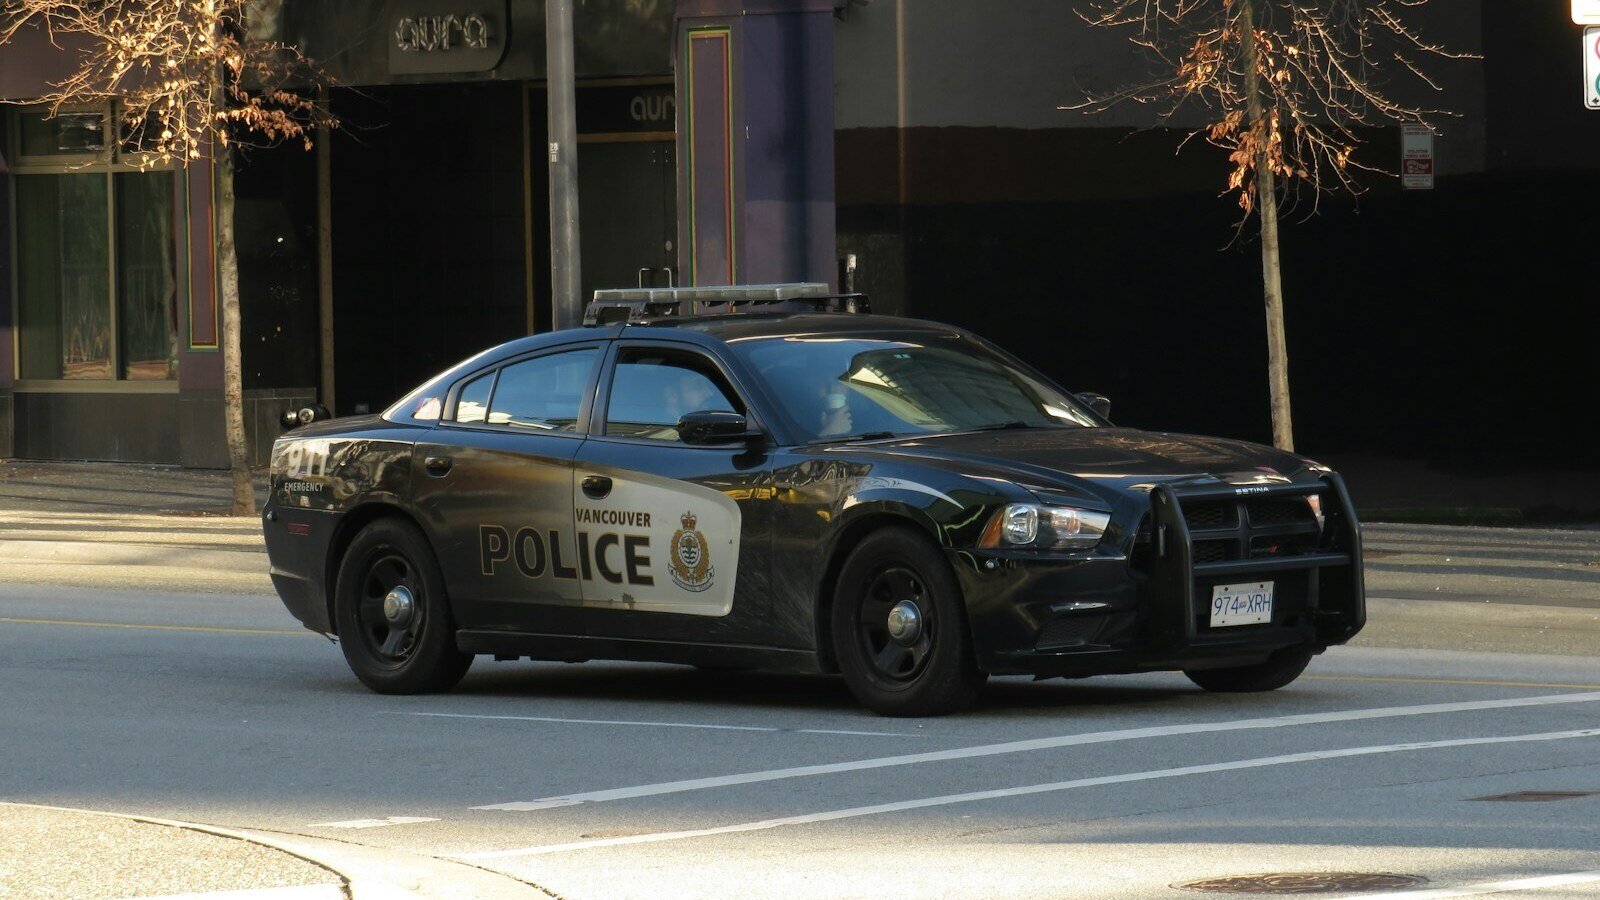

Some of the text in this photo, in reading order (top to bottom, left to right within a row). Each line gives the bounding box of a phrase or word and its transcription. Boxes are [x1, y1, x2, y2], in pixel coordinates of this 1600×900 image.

[396, 14, 487, 51] aura
[287, 440, 330, 479] 911
[284, 482, 324, 492] EMERGENCY
[1235, 486, 1269, 495] SETINA
[576, 508, 651, 528] VANCOUVER
[479, 524, 655, 587] POLICE
